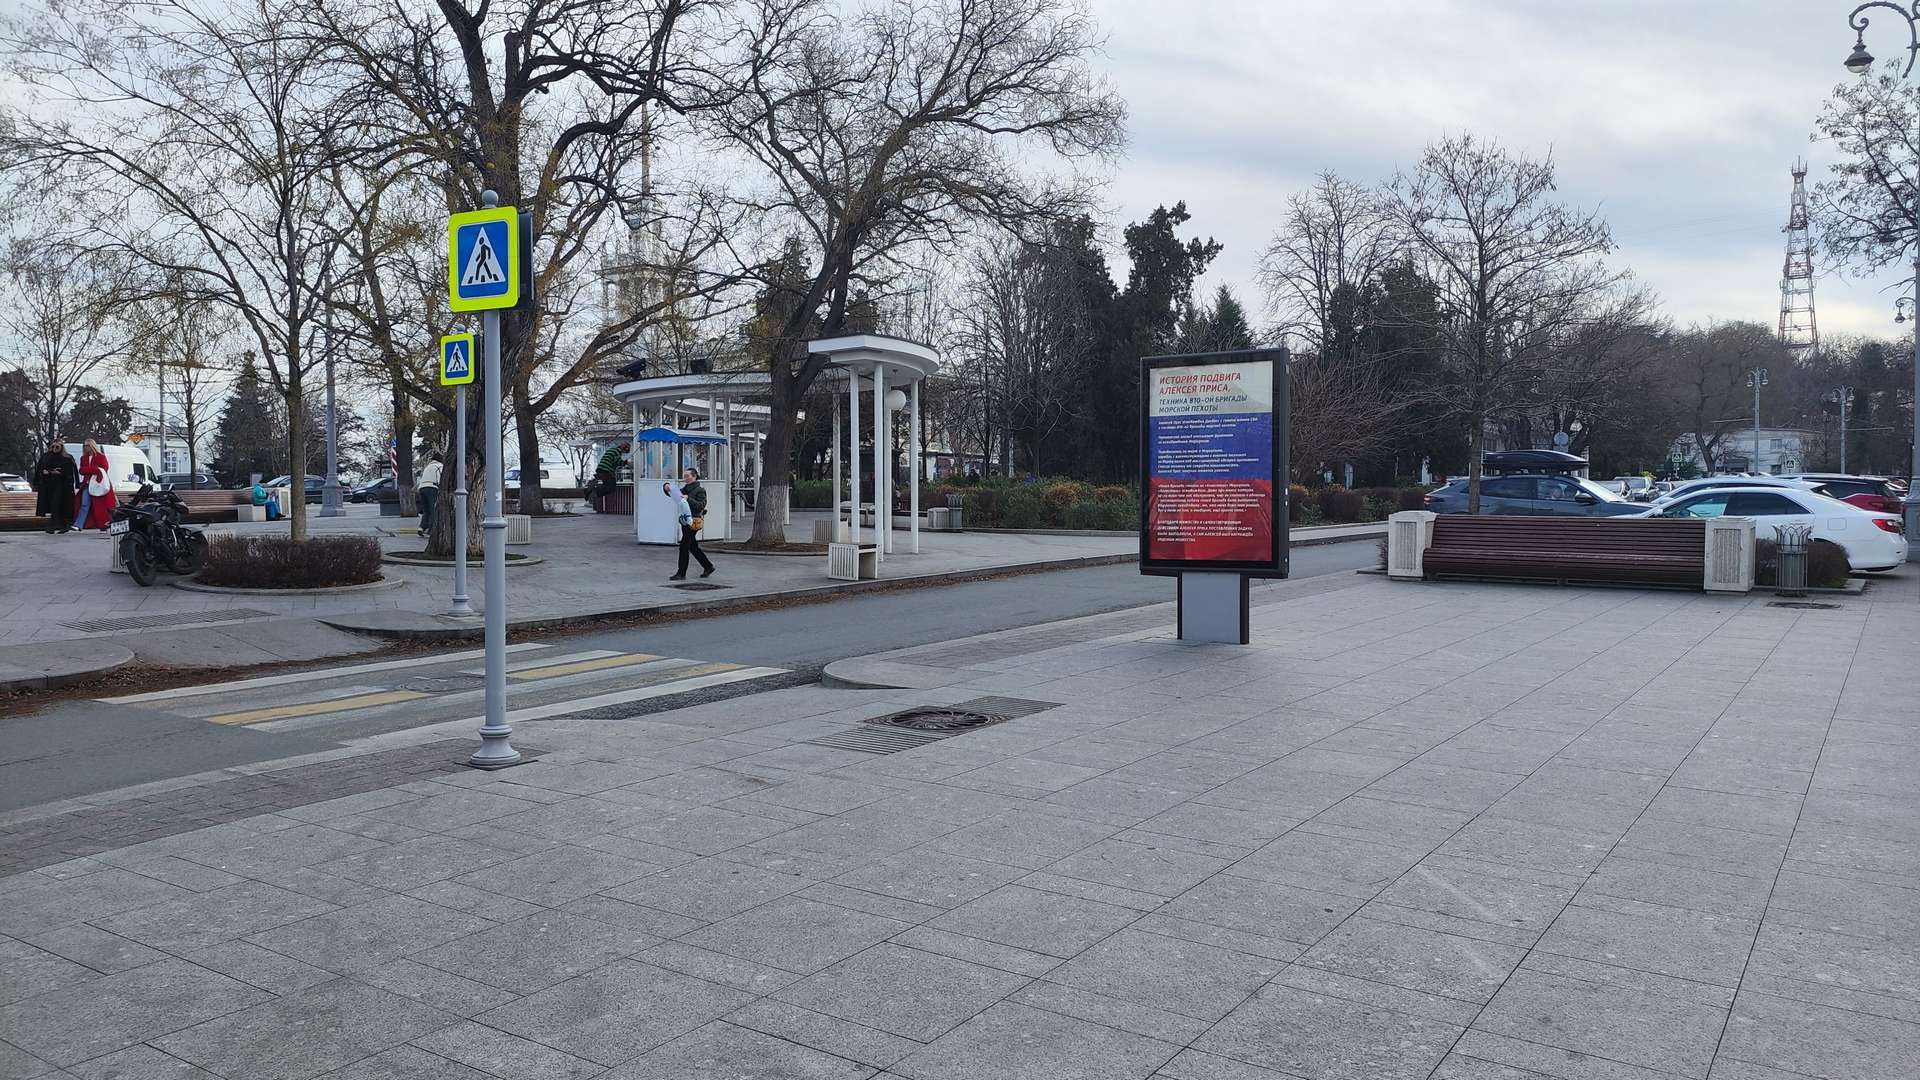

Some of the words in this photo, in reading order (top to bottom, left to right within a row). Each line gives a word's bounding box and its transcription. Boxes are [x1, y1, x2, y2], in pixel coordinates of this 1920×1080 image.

[1160, 375, 1198, 385] ИСТОРИЯ
[1200, 373, 1241, 382] ПОДВИГА
[1160, 385, 1197, 395] АЛЕКСЕЯ
[1199, 384, 1231, 393] ПРИСА,
